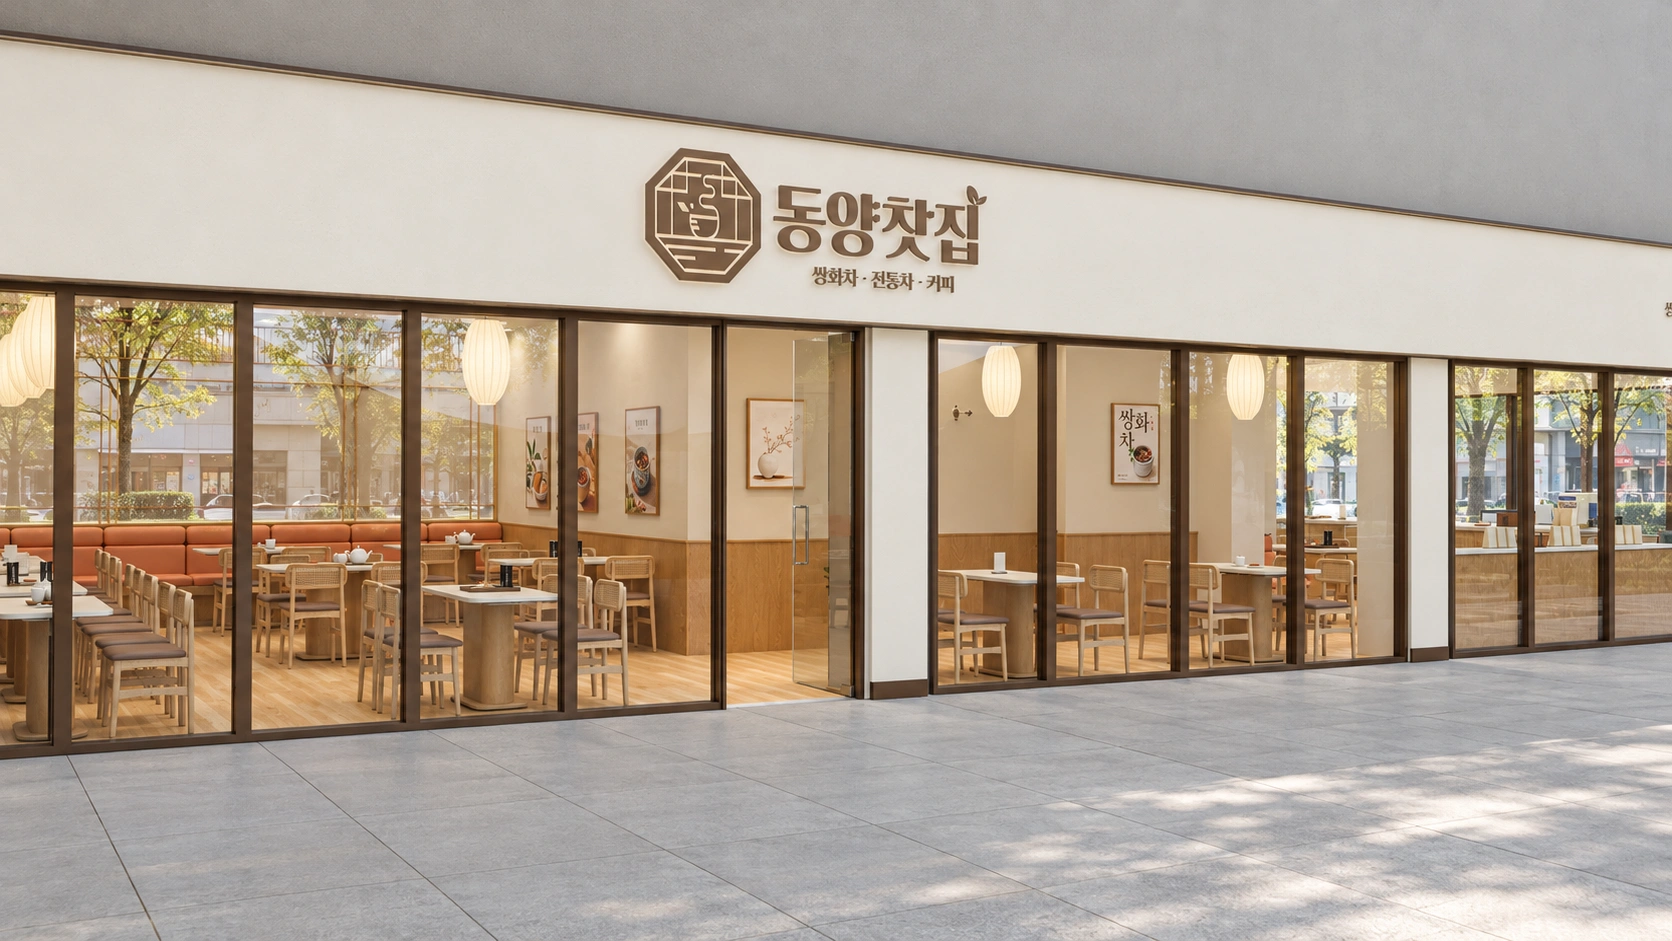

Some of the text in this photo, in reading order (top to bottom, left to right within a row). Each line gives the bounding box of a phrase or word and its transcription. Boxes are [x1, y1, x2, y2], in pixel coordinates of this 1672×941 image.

[773, 184, 980, 266] 동양찻집
[811, 266, 955, 293] 쌍화차 전통차 커피
[1118, 408, 1150, 433] 쌍화
[1119, 431, 1135, 449] 차
